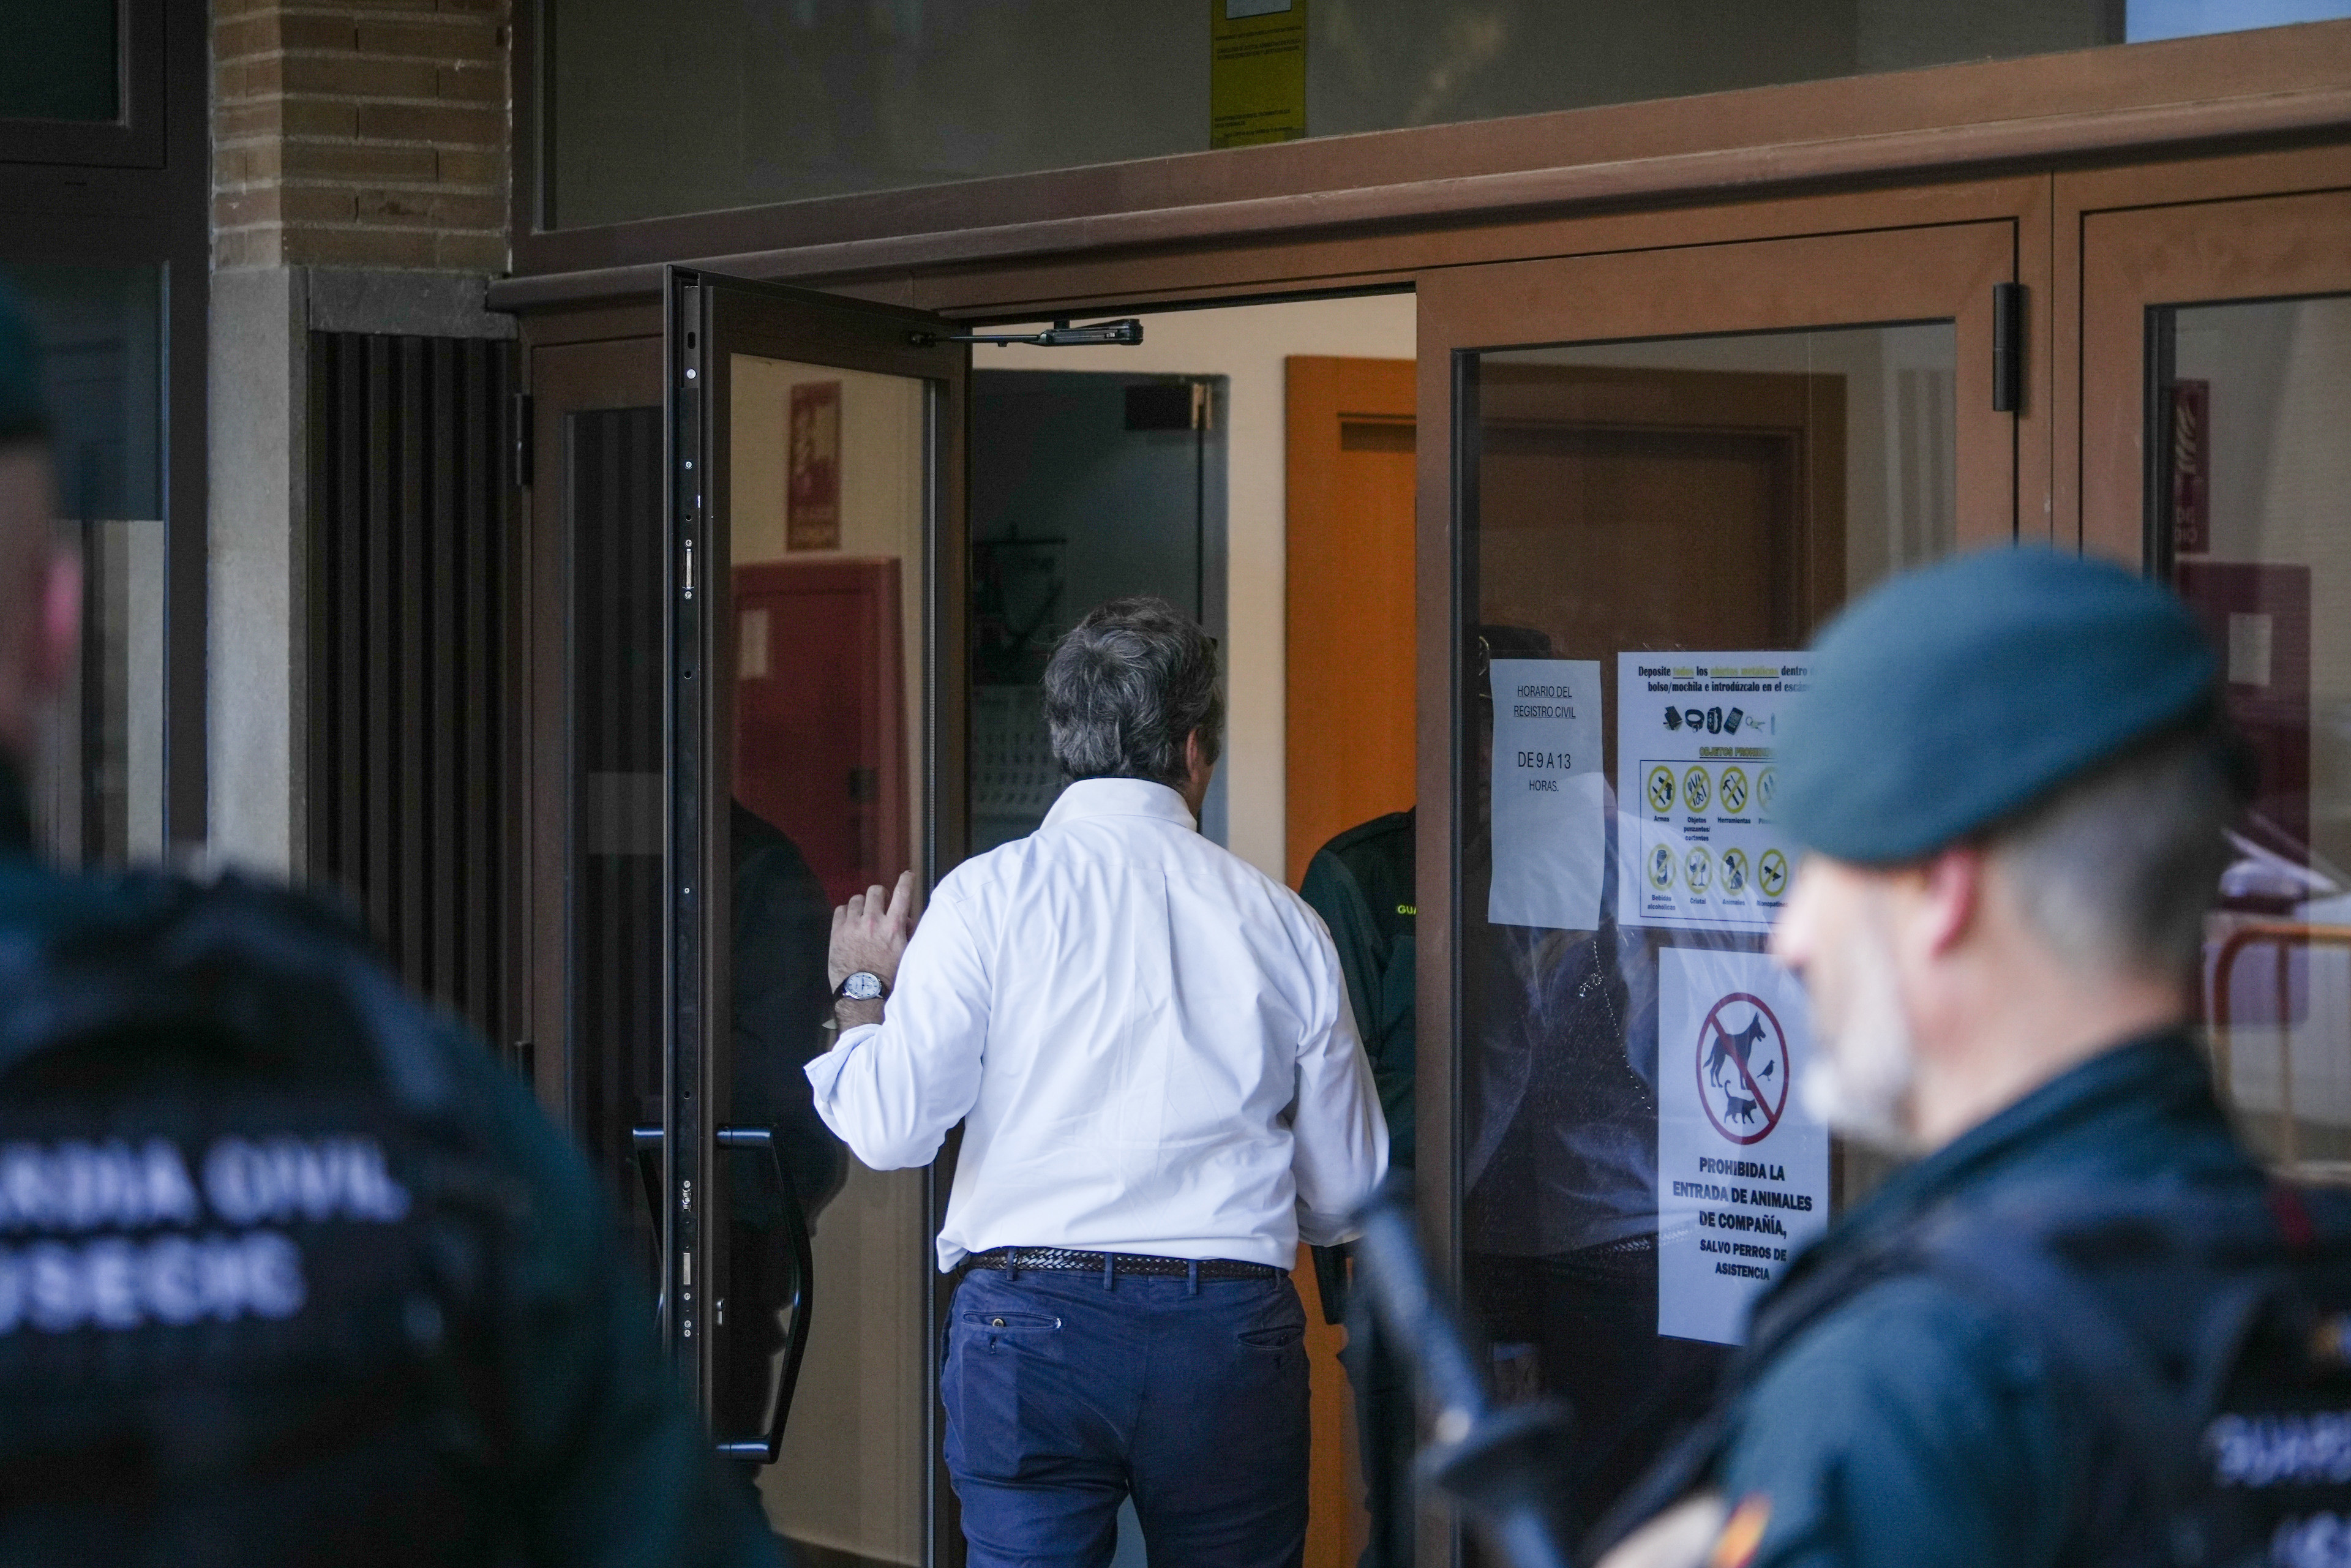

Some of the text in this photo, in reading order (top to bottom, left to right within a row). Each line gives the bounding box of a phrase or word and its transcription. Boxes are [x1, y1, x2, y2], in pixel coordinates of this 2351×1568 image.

[1638, 666, 1671, 678] Deposite
[1697, 666, 1708, 677] los
[1781, 666, 1808, 677] dentro
[1517, 685, 1572, 698] HORARIO DEL
[1648, 681, 1703, 694] bolso/mochila
[1711, 681, 1760, 692] introdúzcalo
[1763, 683, 1772, 692] en
[1775, 681, 1782, 692] el
[1513, 705, 1576, 718] REGISTRO CIVIL
[1700, 746, 1733, 757] OBJETOS
[1518, 751, 1571, 770] DE 9 A 13
[1529, 779, 1559, 792] HORAS.
[1397, 904, 1417, 915] GU
[1700, 1157, 1785, 1182] PROHIBIDA LA
[1673, 1180, 1813, 1212] ENTRADA DE ANIMALES
[1699, 1210, 1787, 1240] DE COMPAÑÍA,
[1700, 1239, 1787, 1262] SALVO PERROS DE
[1715, 1262, 1770, 1281] ASISTENCIA
